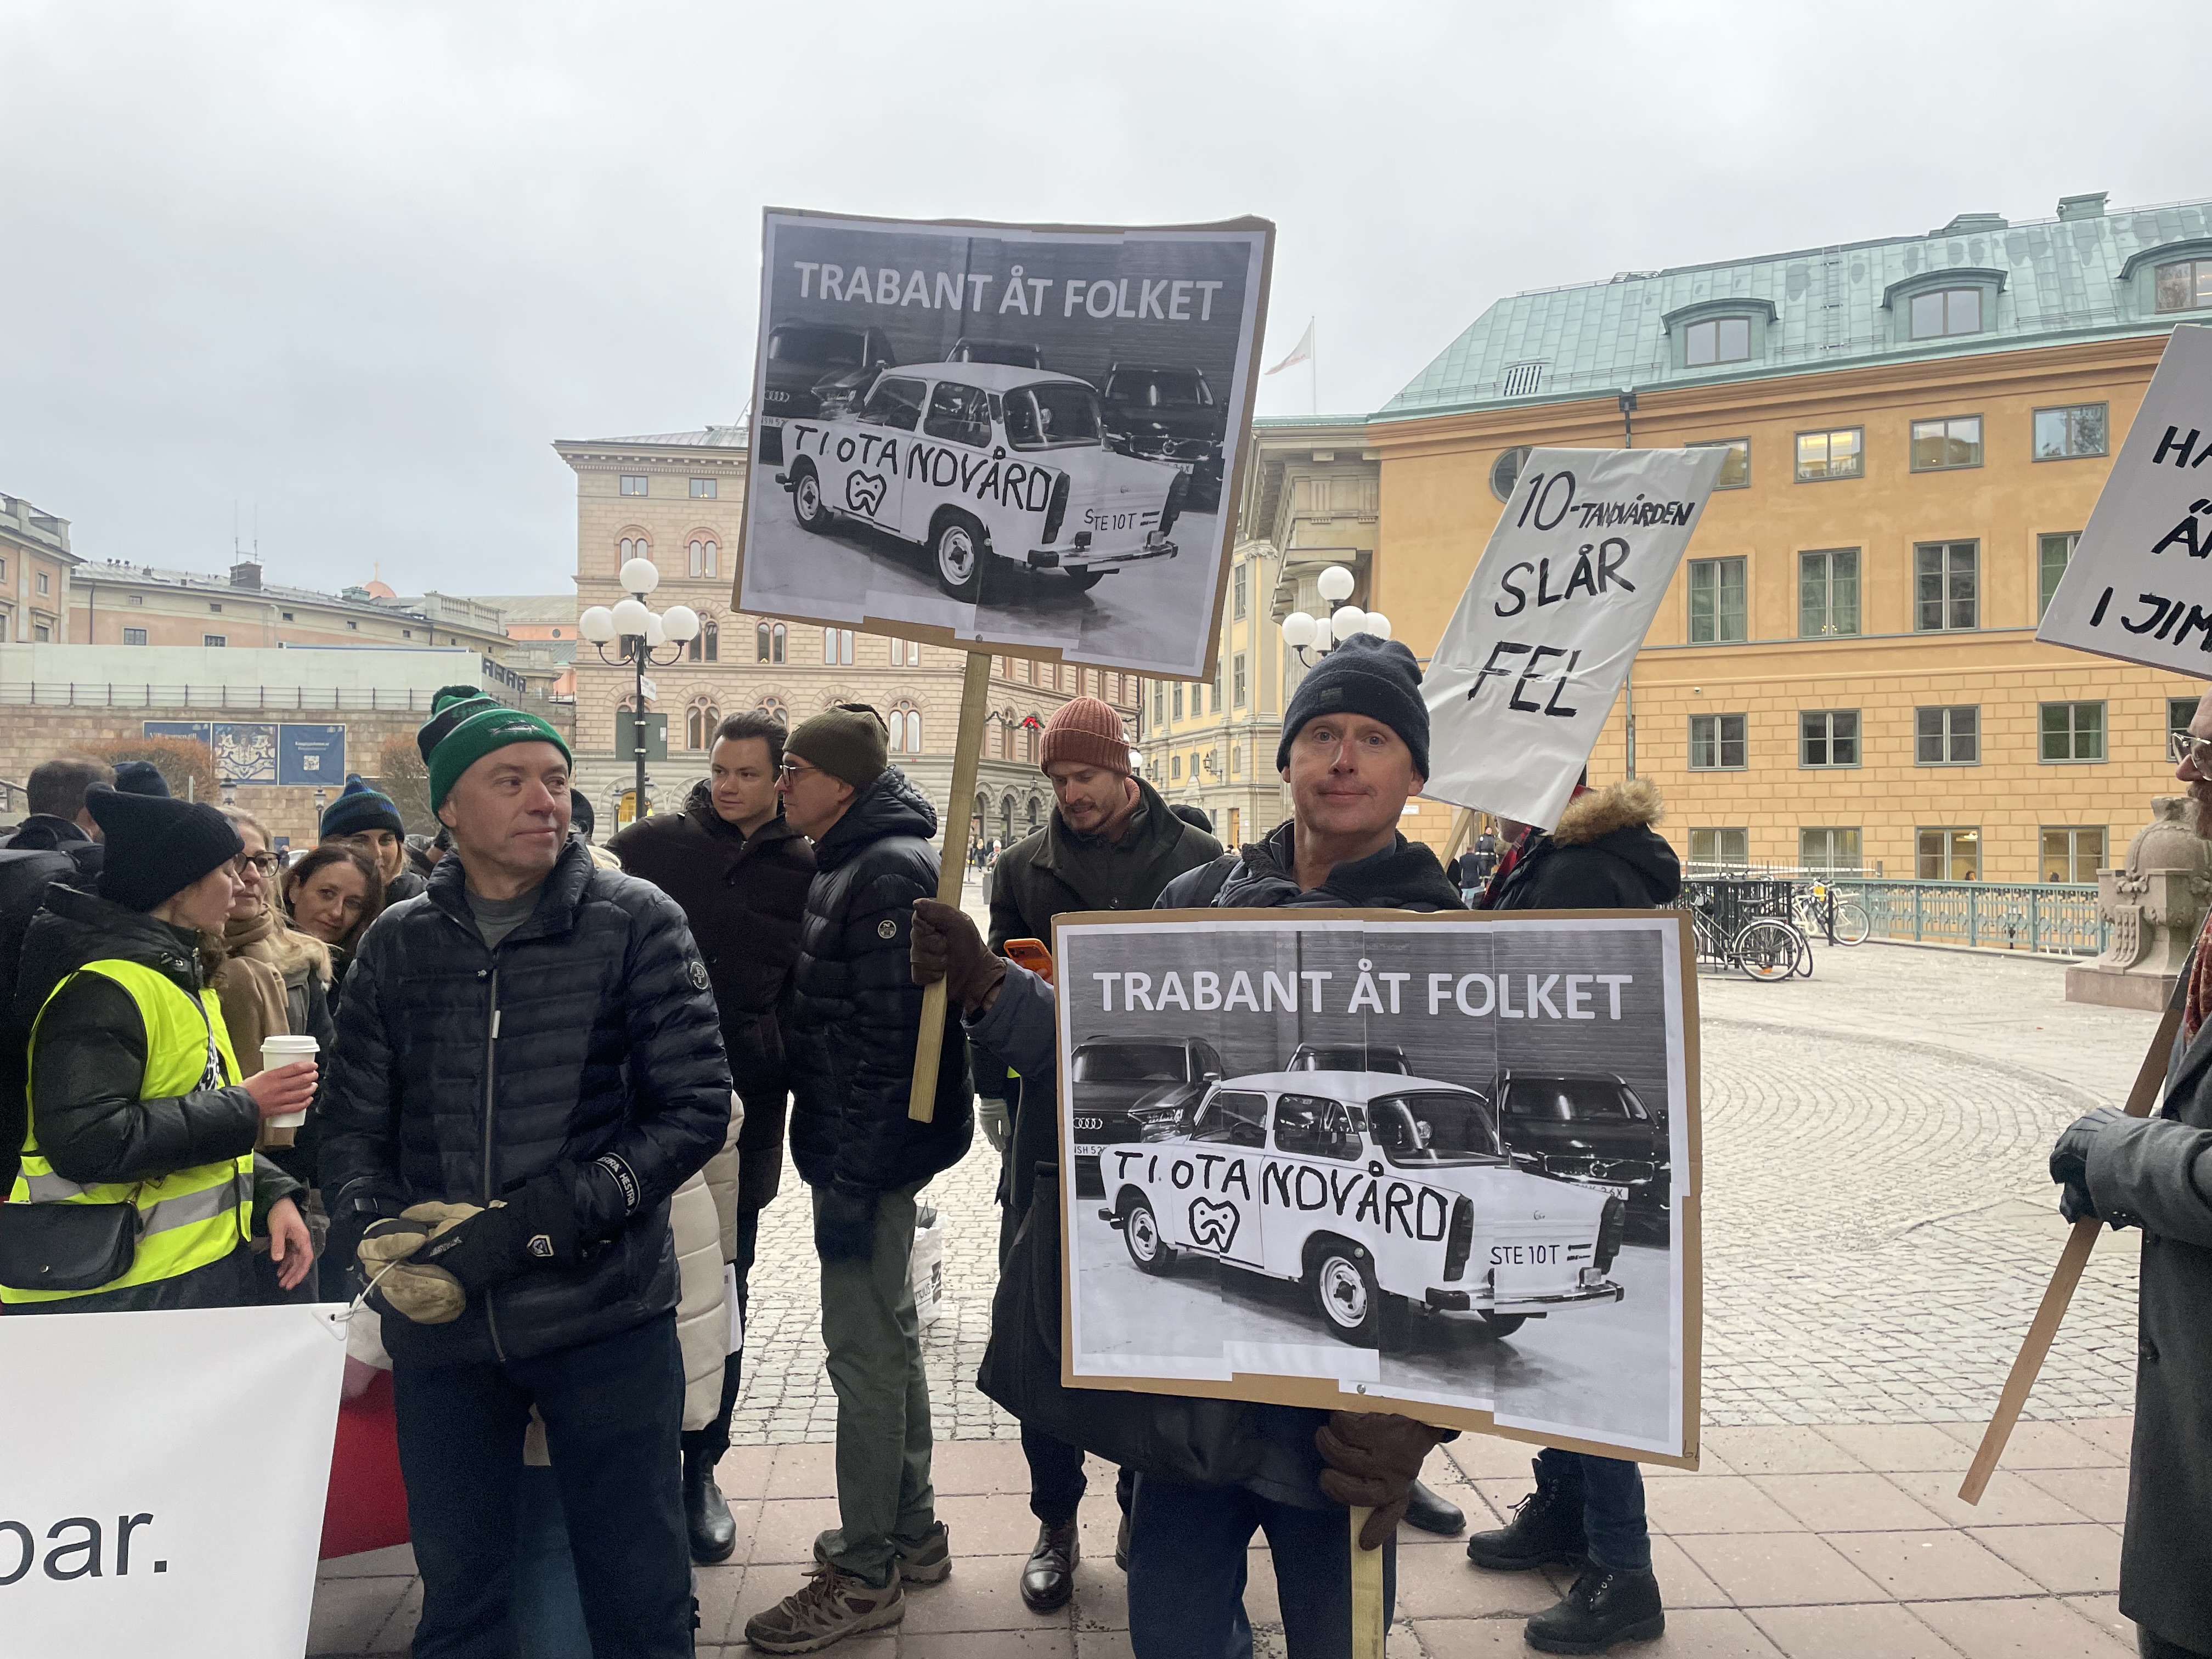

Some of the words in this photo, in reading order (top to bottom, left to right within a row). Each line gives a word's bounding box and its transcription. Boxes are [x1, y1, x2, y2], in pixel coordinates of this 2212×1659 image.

[794, 262, 992, 312] TRABANT
[1000, 265, 1053, 316] ÅT
[1064, 279, 1223, 321] FOLKET
[1084, 509, 1109, 531] STE
[1494, 537, 1637, 617] SLÅR
[2089, 586, 2113, 627] I
[1468, 640, 1582, 718] FEL
[1093, 970, 1333, 1014] TRABANT
[1347, 957, 1411, 1014] ÅT
[1427, 973, 1633, 1020] FOLKET
[1074, 1146, 1088, 1154] SH
[1489, 1246, 1523, 1265] STE
[1528, 1245, 1560, 1265] 10T
